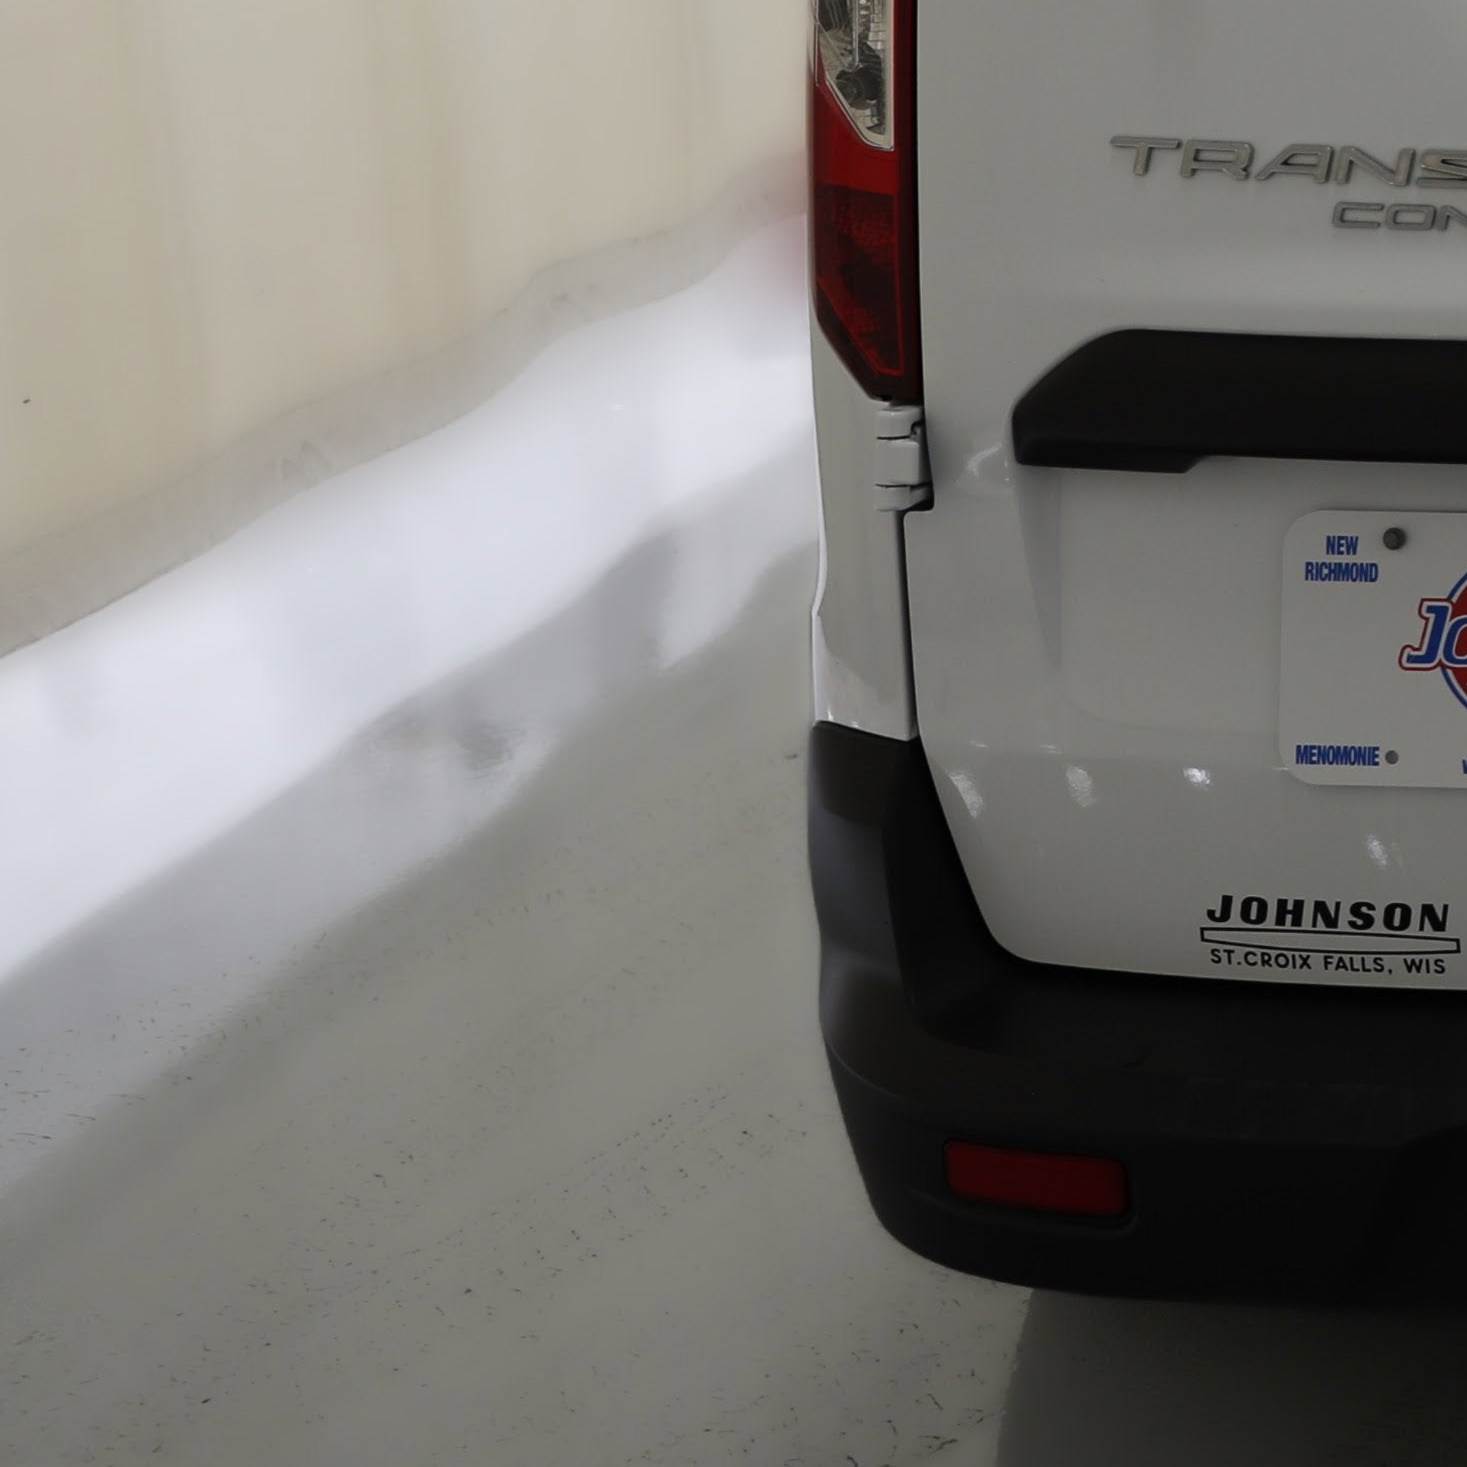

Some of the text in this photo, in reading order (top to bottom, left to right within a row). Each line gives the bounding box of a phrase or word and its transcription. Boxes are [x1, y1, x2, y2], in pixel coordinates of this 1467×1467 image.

[1325, 535, 1358, 556] NEW
[1305, 562, 1379, 583] RICHMOND
[1296, 744, 1380, 766] MENOMONIE
[1206, 894, 1449, 932] JOHNSON
[1323, 955, 1393, 975] FALLS,
[1403, 958, 1446, 974] WIS
